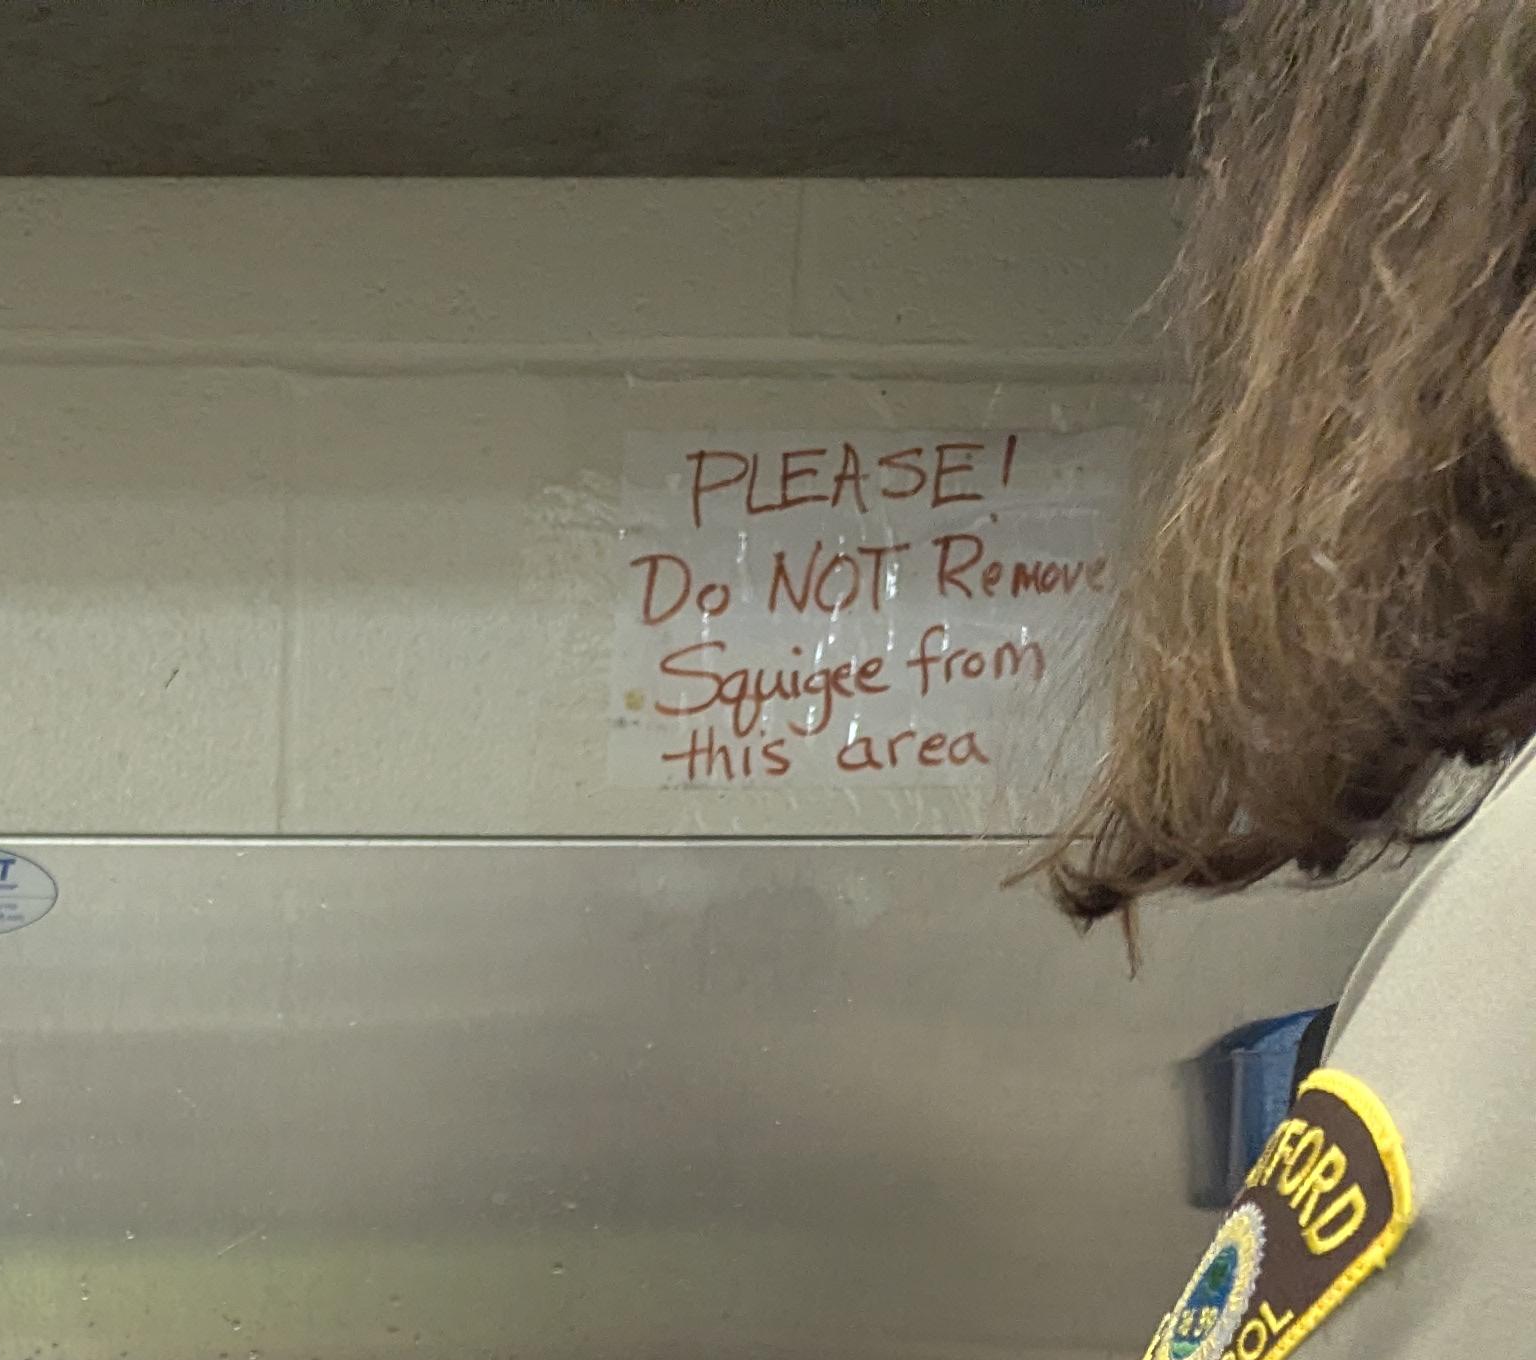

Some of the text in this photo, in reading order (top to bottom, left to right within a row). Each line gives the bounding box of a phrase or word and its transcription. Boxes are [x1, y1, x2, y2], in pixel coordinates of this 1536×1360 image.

[686, 433, 1018, 528] PLEASE!
[630, 533, 1107, 626] Do NOT Remove
[654, 625, 1046, 736] Squigee from
[662, 729, 990, 781] this area
[1245, 1118, 1368, 1255] FORD
